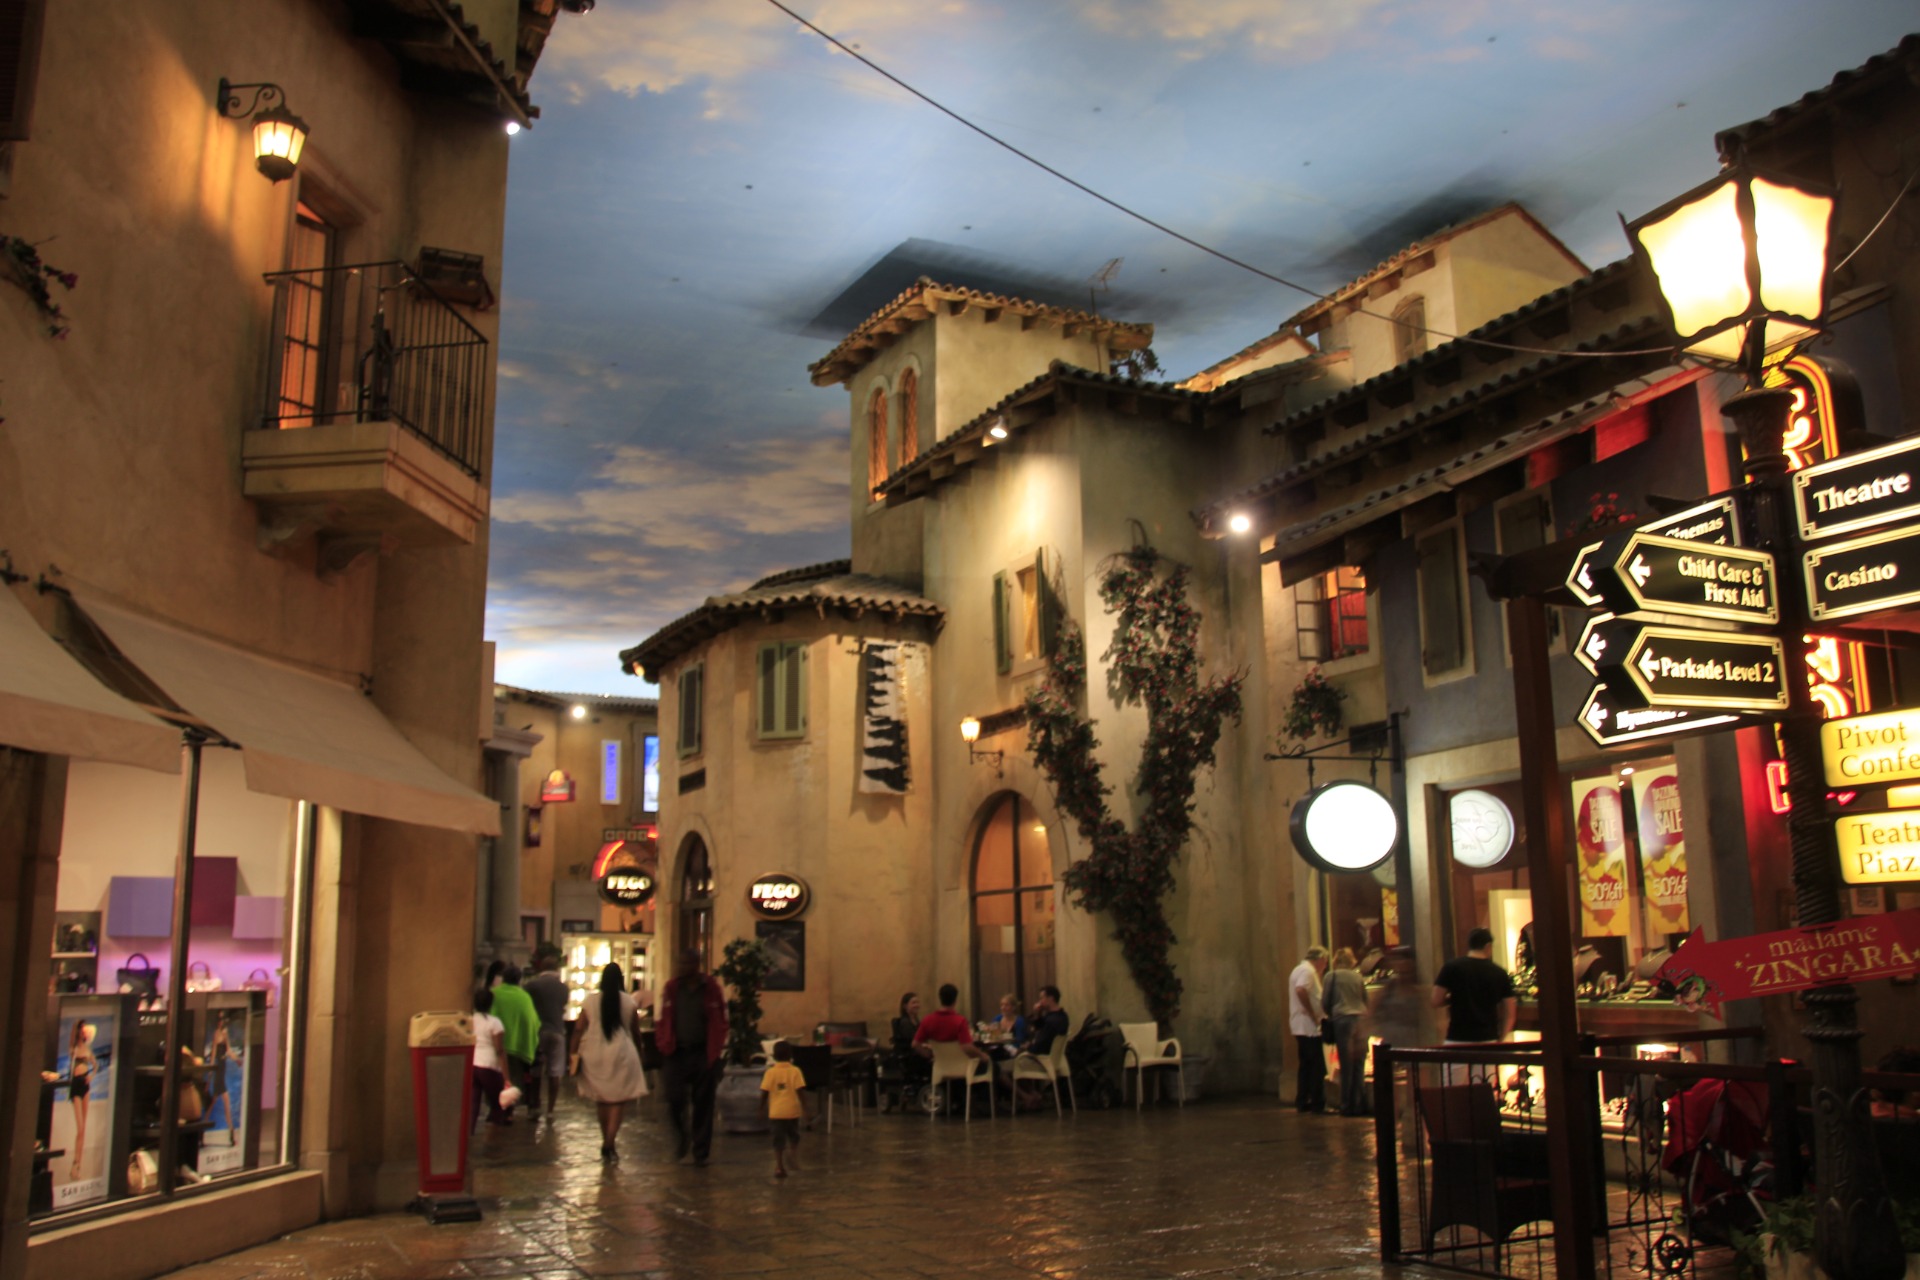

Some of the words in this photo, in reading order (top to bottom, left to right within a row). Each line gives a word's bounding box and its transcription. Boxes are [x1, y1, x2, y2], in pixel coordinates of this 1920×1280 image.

[1813, 472, 1910, 513] Theatre
[1678, 556, 1717, 579] Child
[1718, 562, 1751, 584] Care
[1752, 567, 1763, 586] &
[1824, 563, 1898, 591] Casino
[1704, 582, 1739, 605] First
[1741, 587, 1765, 608] Aid
[1660, 656, 1723, 680] Parkade
[1724, 661, 1761, 682] Level
[1763, 662, 1775, 682] 2
[1837, 722, 1907, 750] Pivot
[1840, 747, 1920, 778] Confe
[1591, 819, 1618, 843] SALE
[1654, 809, 1684, 836] SALE
[1857, 851, 1918, 875] Piaz
[607, 875, 651, 890] FEGO
[751, 883, 800, 899] FEGO
[1769, 926, 1878, 957] madame
[1746, 942, 1914, 987] ZINGARA
